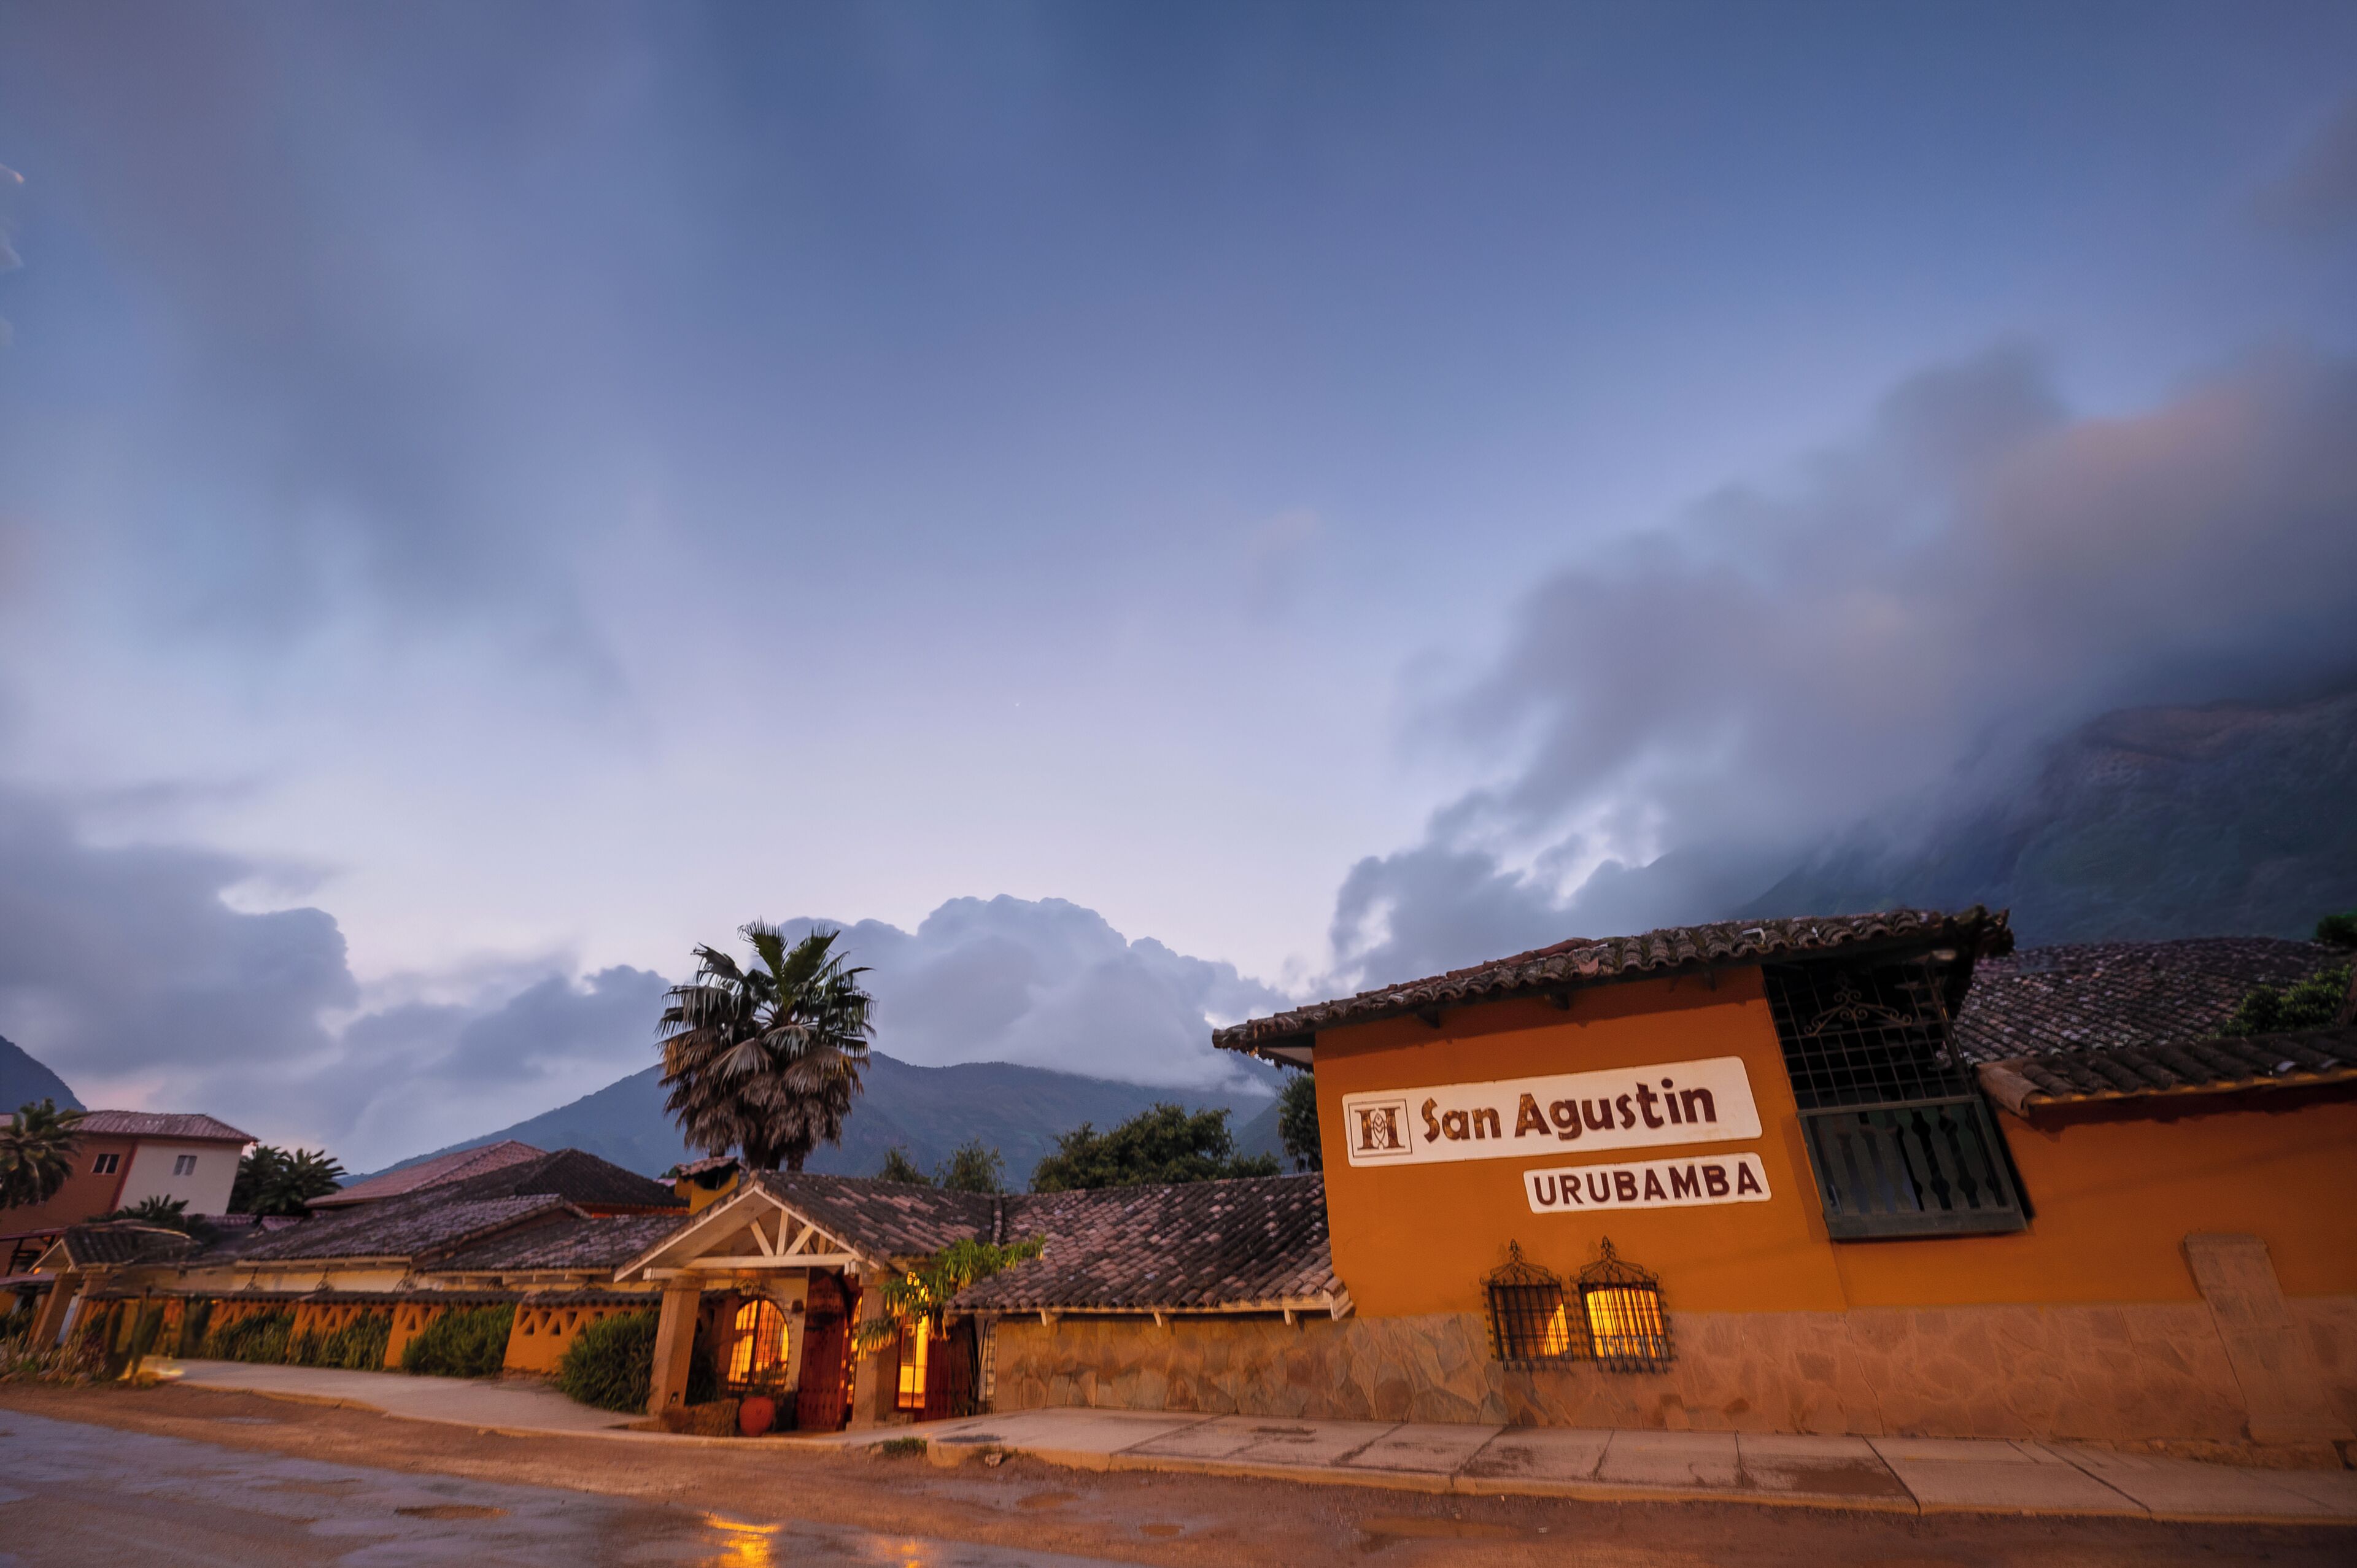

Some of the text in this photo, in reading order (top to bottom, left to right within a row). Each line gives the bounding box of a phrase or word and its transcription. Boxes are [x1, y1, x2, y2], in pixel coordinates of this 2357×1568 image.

[1421, 1078, 1717, 1143] San Agustin
[1533, 1161, 1763, 1205] URUBAMBA
